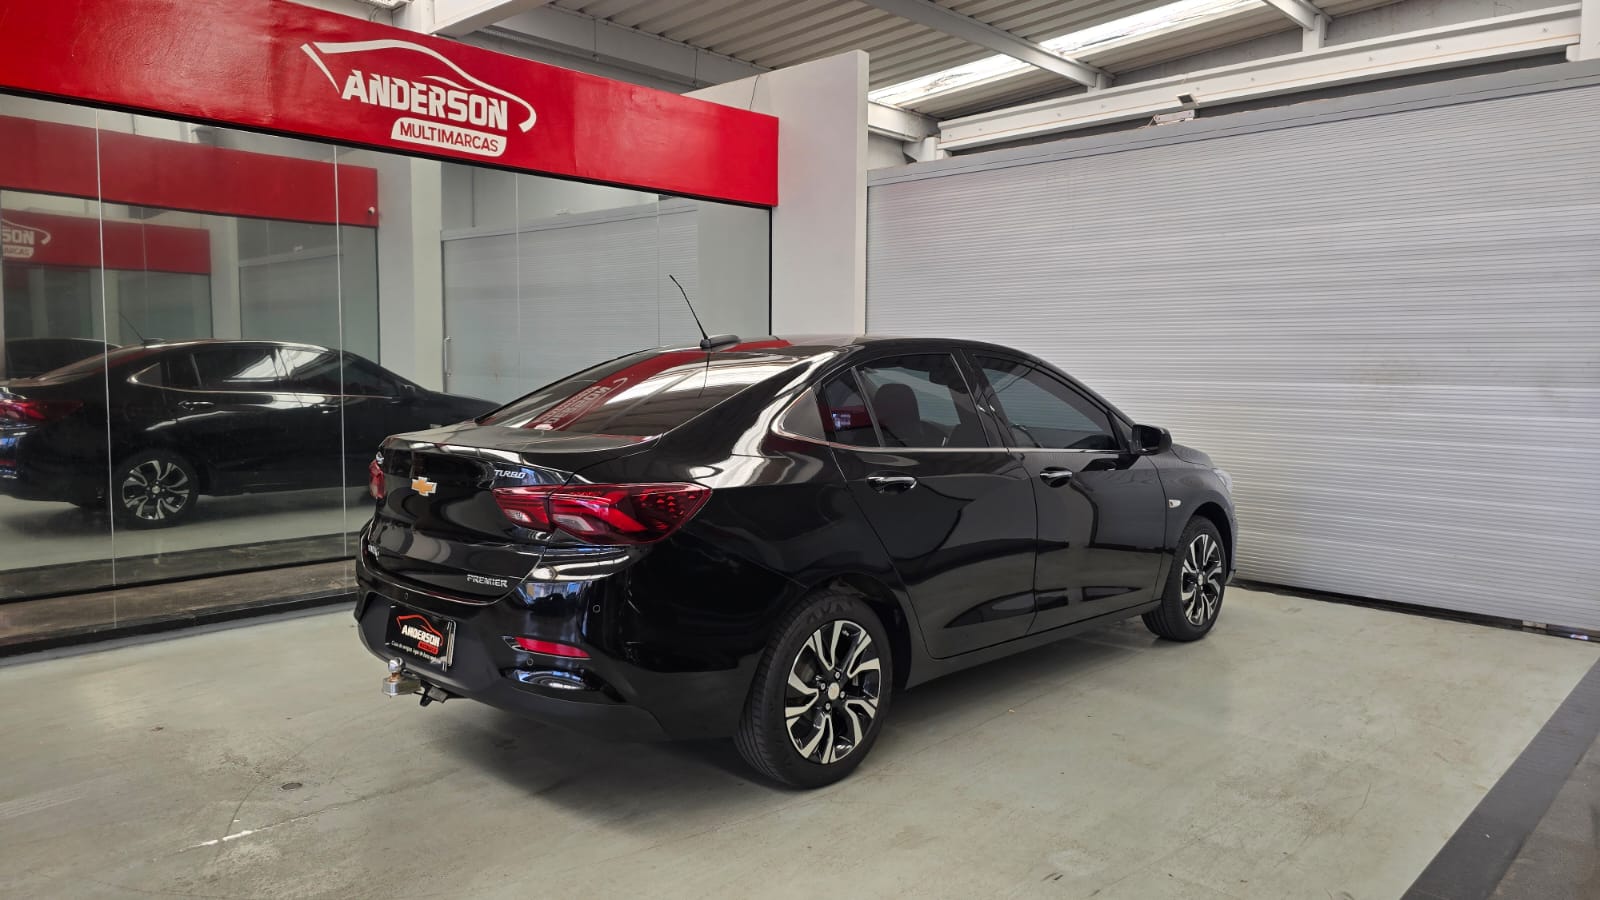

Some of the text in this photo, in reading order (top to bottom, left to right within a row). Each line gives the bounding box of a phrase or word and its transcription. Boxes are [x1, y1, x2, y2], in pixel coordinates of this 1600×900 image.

[342, 69, 508, 131] ANDERSON
[400, 121, 499, 153] MULTIMARCAS
[494, 469, 527, 479] TURBO
[467, 574, 508, 588] PREMIER
[401, 624, 441, 648] ANDERSON
